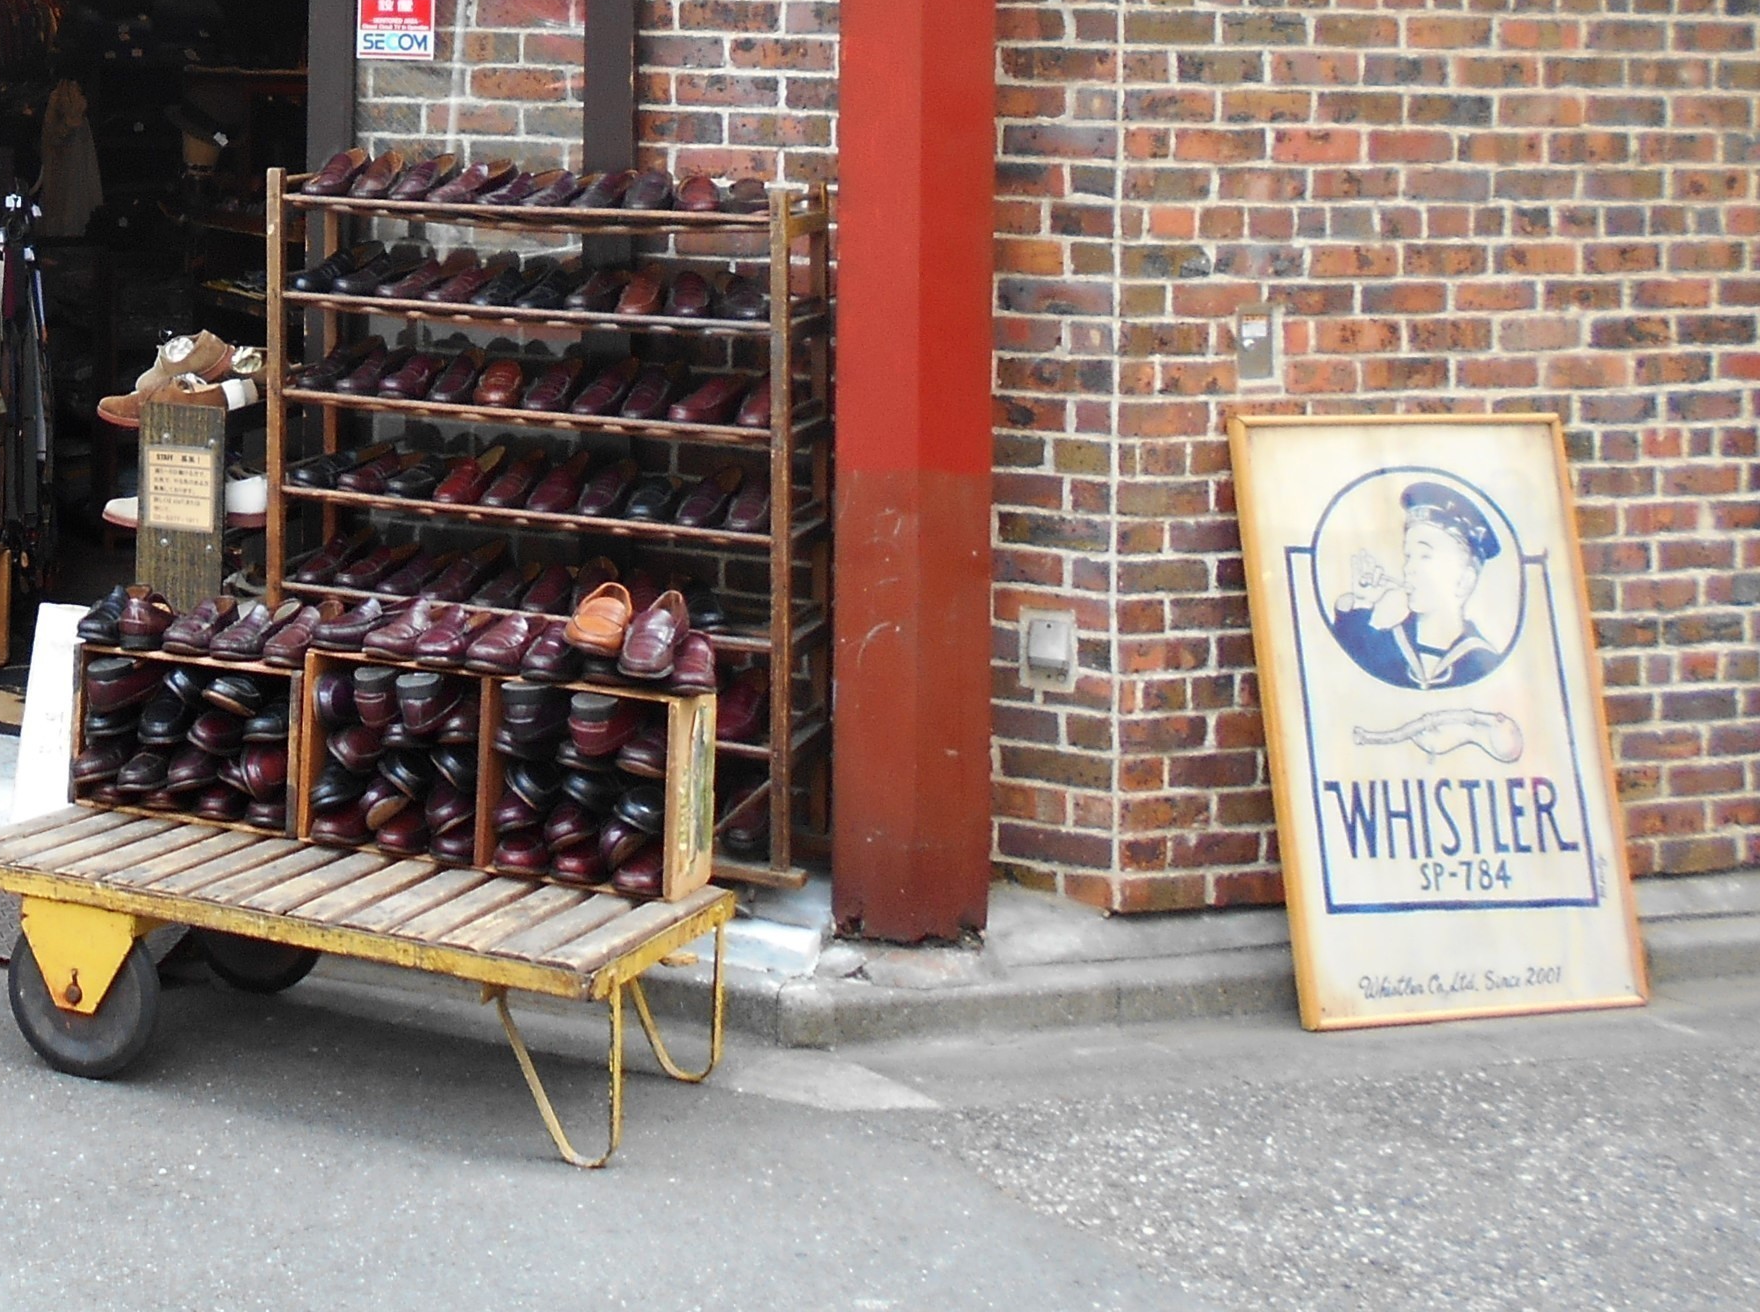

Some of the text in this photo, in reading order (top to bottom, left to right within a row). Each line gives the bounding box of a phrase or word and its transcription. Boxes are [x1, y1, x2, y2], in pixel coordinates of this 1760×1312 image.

[363, 33, 428, 51] SECOM
[1324, 777, 1579, 860] WHISTLER
[1419, 859, 1512, 892] SP-784
[1359, 975, 1424, 999] Whistler
[1485, 970, 1521, 990] Since
[1527, 966, 1562, 985] 2001
